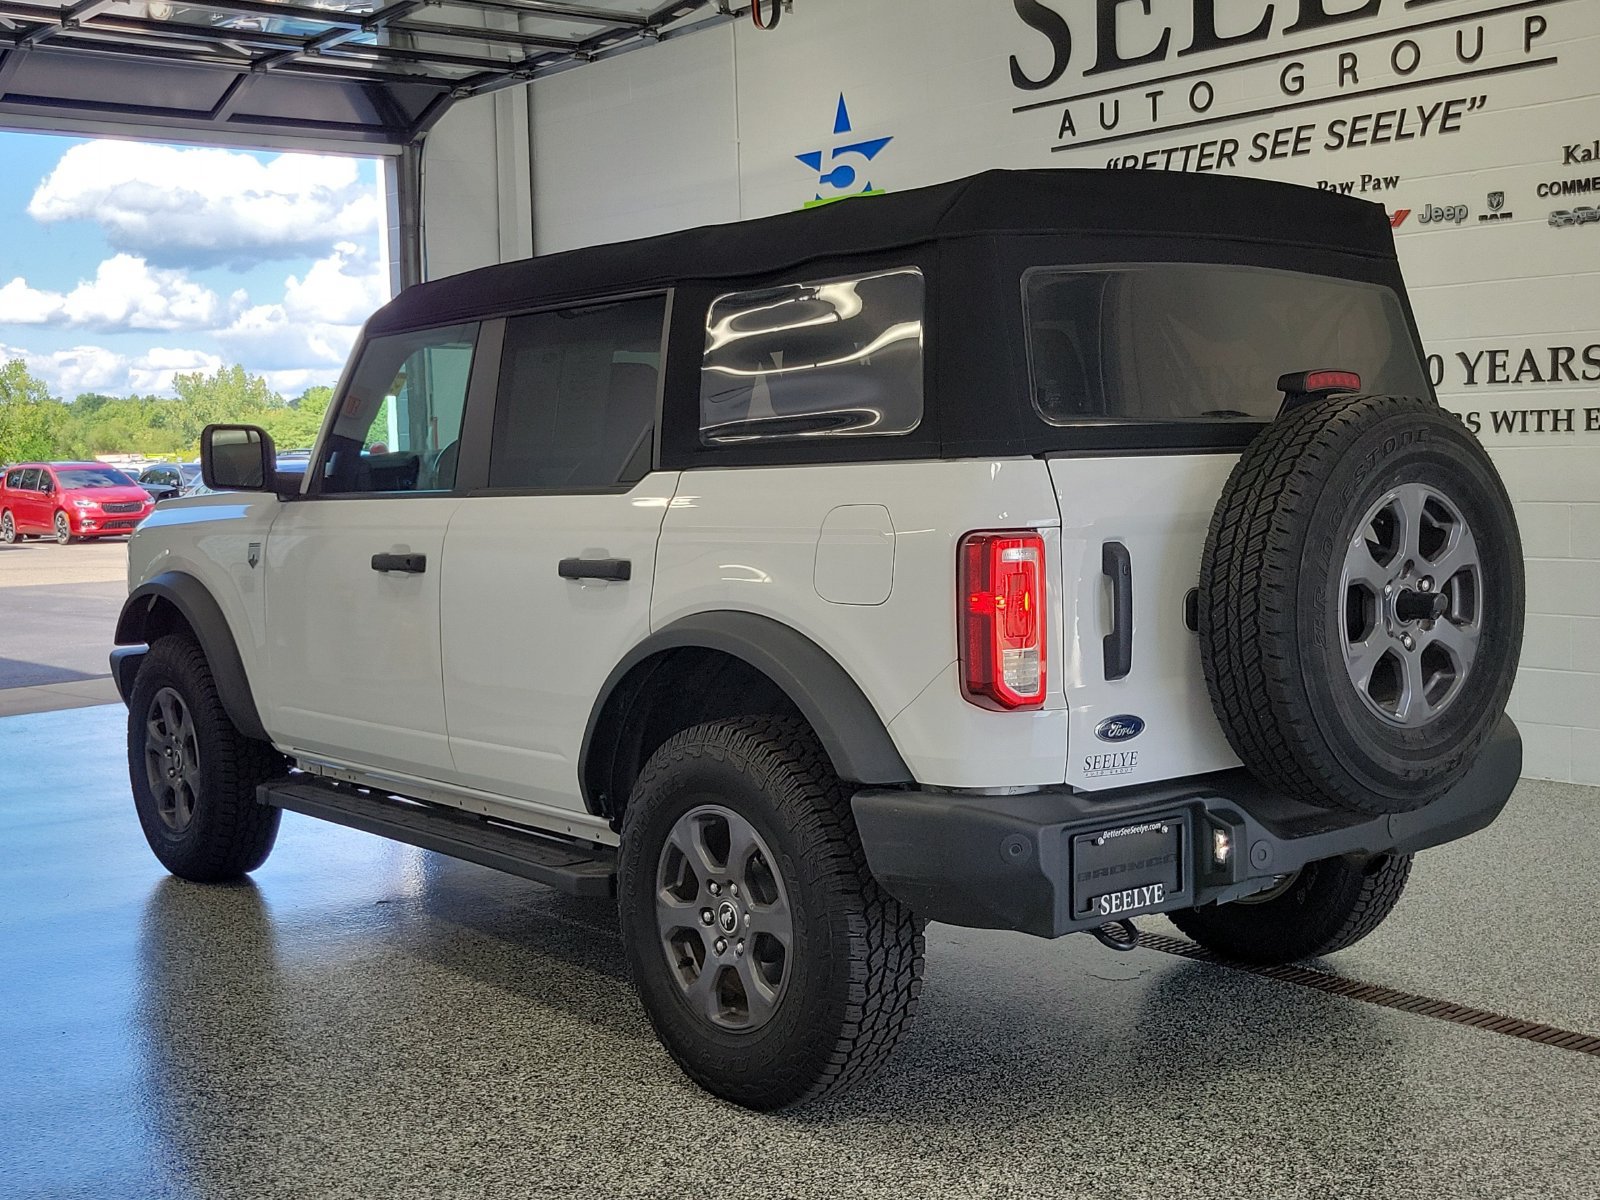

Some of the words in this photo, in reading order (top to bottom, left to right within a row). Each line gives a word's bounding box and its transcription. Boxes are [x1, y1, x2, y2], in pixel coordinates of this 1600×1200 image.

[1058, 80, 1215, 139] AUTO
[1279, 14, 1547, 96] GROUP
[1247, 123, 1317, 162] SEE
[1359, 173, 1400, 192] Paw
[1417, 203, 1469, 224] Jeep
[1455, 344, 1600, 386] YEARS
[1489, 408, 1575, 434] WITH
[1107, 721, 1135, 738] Ford
[1083, 751, 1139, 771] SEELYE
[1102, 822, 1162, 840] BetterSeeSeelye.com
[1100, 883, 1165, 916] SEELYE
